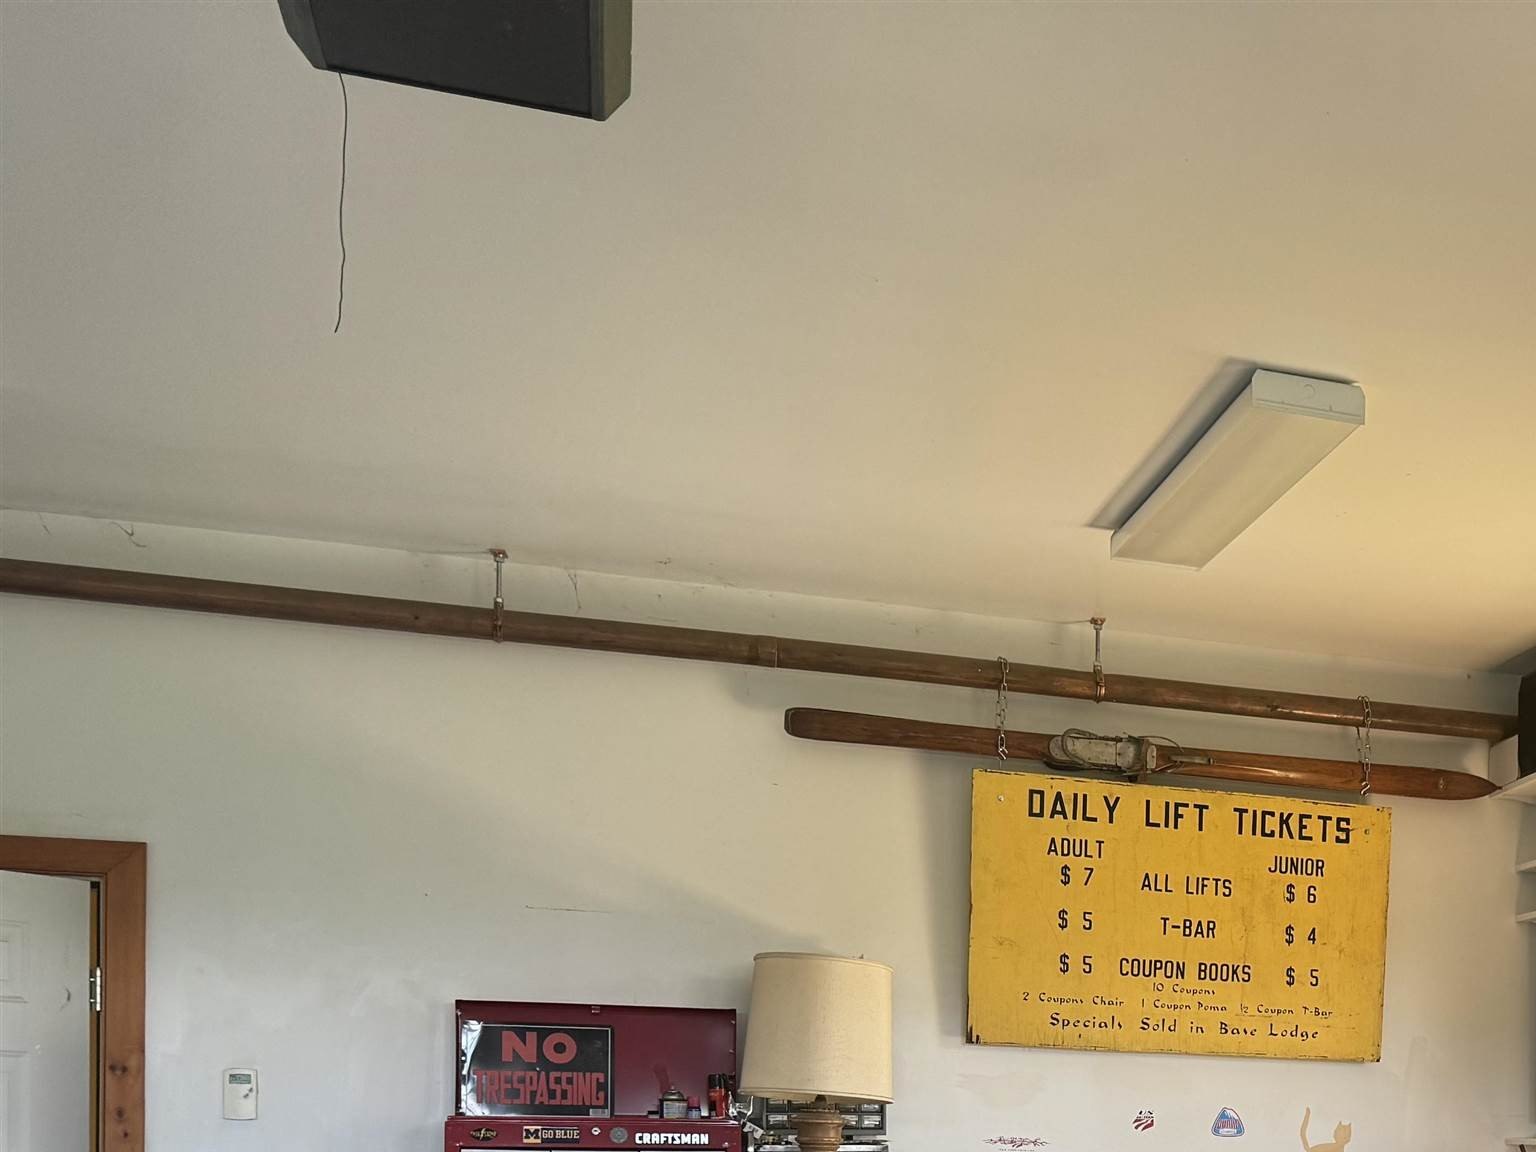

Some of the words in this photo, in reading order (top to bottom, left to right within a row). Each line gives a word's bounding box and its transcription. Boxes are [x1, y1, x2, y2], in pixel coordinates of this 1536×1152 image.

[1027, 788, 1121, 824] DAILY
[1145, 799, 1209, 832] LIFT
[1233, 807, 1351, 844] TICKETS
[1047, 837, 1104, 859] ADULT
[1084, 867, 1094, 886] 7
[1268, 855, 1325, 877] JUNIOR
[1141, 873, 1173, 893] ALL
[1186, 875, 1232, 897] LIFTS
[1307, 885, 1317, 904] 6
[1082, 911, 1093, 931] 5
[1160, 917, 1216, 939] T-BAR
[1307, 927, 1317, 945] 4
[1082, 956, 1093, 974] 5
[1119, 958, 1186, 979] COUPON
[1197, 962, 1251, 983] BOOKS
[1309, 969, 1319, 987] 5
[1172, 983, 1216, 996] Coupons
[1022, 992, 1029, 1001] 2
[1038, 992, 1084, 1005] Coupons
[1092, 995, 1124, 1007] Chair
[1153, 999, 1191, 1011] Coupon
[1197, 1001, 1227, 1012] Poma
[1257, 1004, 1294, 1016] Coupon
[1302, 1006, 1333, 1019] T-Bar
[1049, 1012, 1123, 1030] Specials
[1139, 1017, 1176, 1033] Sold
[1190, 1020, 1204, 1035] in
[1219, 1022, 1257, 1037] Base
[1268, 1023, 1318, 1042] Lodge
[501, 1030, 577, 1065] NO
[473, 1069, 605, 1106] TRESPASSING
[524, 1128, 540, 1140] M
[542, 1130, 554, 1139] GO
[555, 1130, 580, 1139] BLUE
[635, 1133, 709, 1145] CRAFTSMAN
